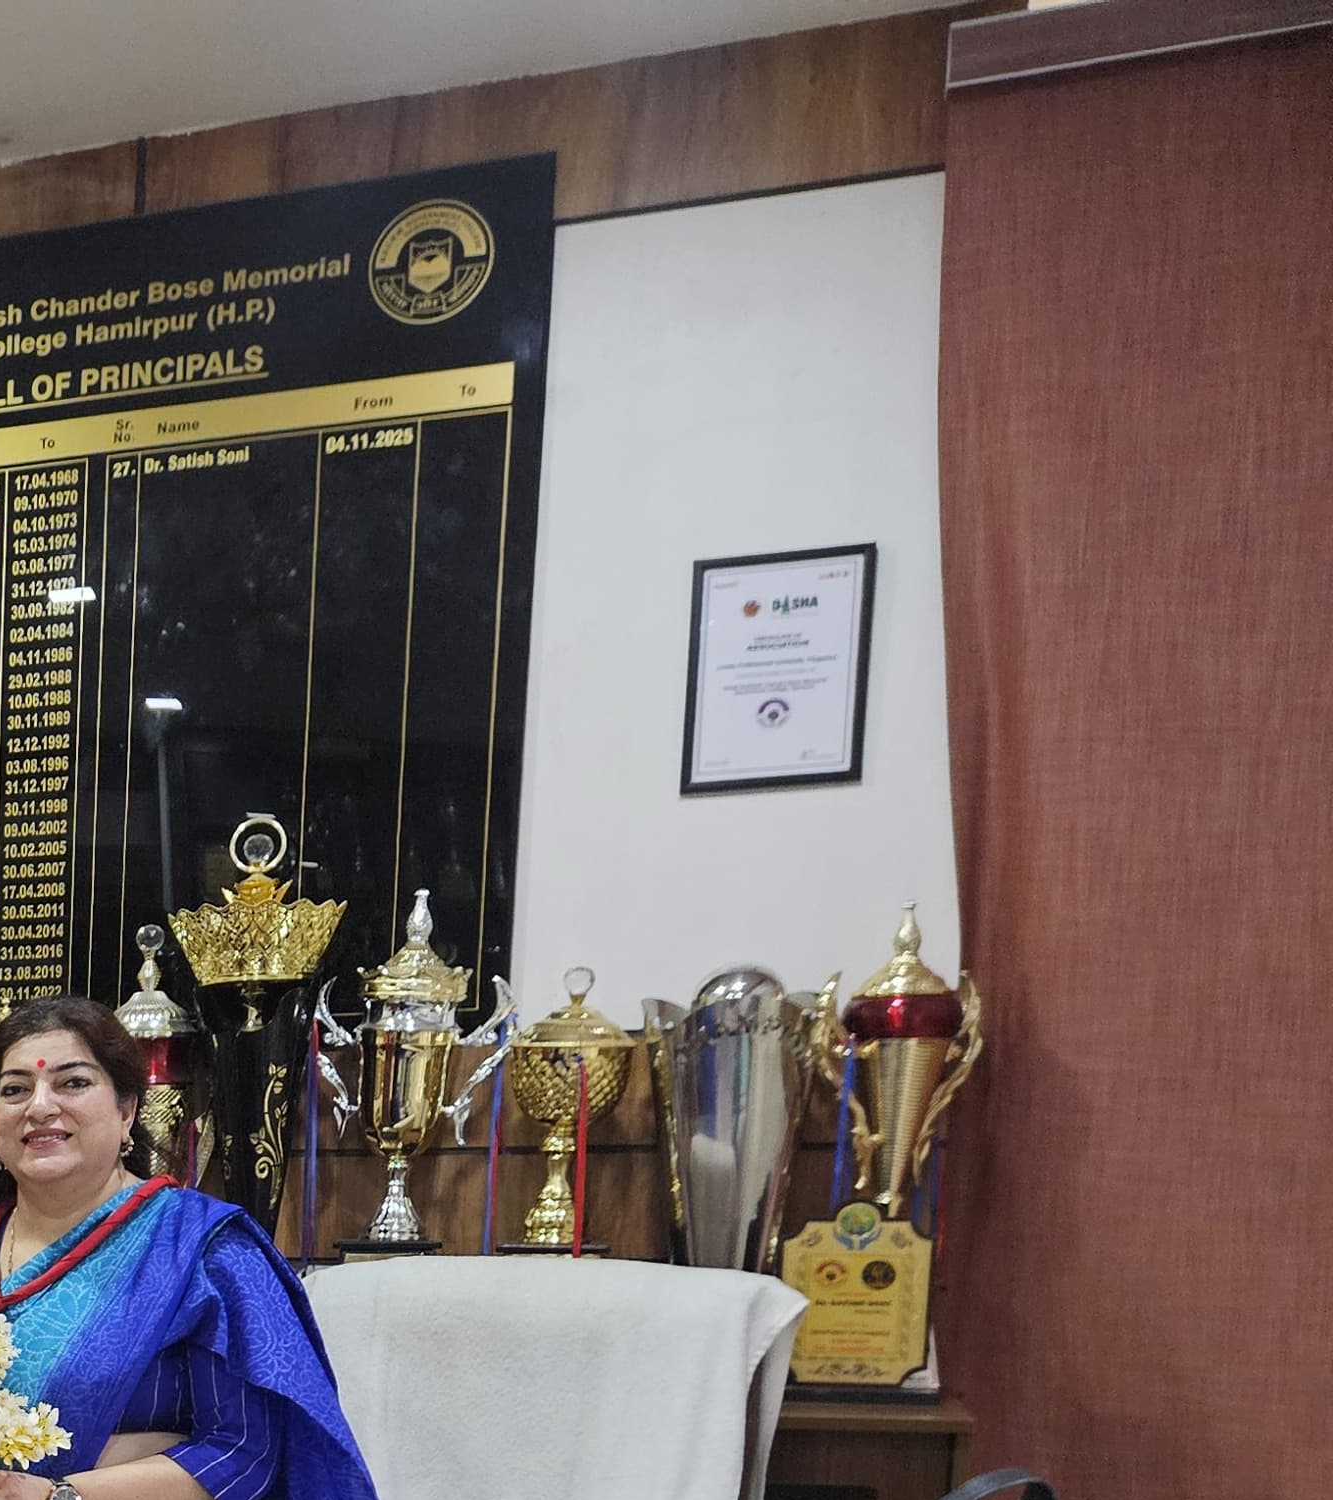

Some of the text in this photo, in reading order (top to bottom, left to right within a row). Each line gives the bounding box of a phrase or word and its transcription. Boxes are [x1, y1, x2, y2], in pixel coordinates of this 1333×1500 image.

[31, 288, 140, 322] Chander
[148, 277, 214, 304] Bose
[223, 253, 351, 293] Memorial
[76, 311, 198, 346] Hamirpur
[207, 296, 275, 332] (H.P.)
[31, 371, 72, 401] OF
[80, 345, 264, 394] PRINCIPALS
[157, 384, 476, 434] Name From To
[40, 437, 55, 450] To
[112, 461, 136, 479] 27.
[144, 457, 164, 475] Dr.
[168, 450, 214, 472] Satish
[217, 445, 250, 467] Soni
[14, 468, 79, 491] 17.04.1968
[13, 489, 78, 512] 09.10.1970
[12, 511, 77, 535] 04.10.1973
[12, 532, 77, 555] 15.03.1974
[11, 553, 76, 576] 03.08.1977
[10, 600, 75, 620] 30.09.1982
[9, 621, 74, 643] 02.04.1984
[8, 645, 73, 667] 04.11.1986
[8, 668, 72, 690] 29.02.1988
[7, 689, 72, 710] 10.06.1988
[6, 710, 71, 730] 30.11.1989
[6, 733, 70, 754] 12.12.1992
[5, 755, 69, 775] 03.08.1996
[4, 776, 69, 796] 31.12.1997
[4, 798, 68, 817] 30.11.1998
[3, 819, 68, 838] 09.04.2002
[3, 840, 67, 859] 10.02.2005
[2, 861, 66, 880] 30.06.2007
[2, 882, 66, 901] 17.04.2008
[1, 902, 65, 920] 30.05.2011
[0, 922, 64, 941] 30.04.2014
[0, 943, 63, 961] 31.03.2016
